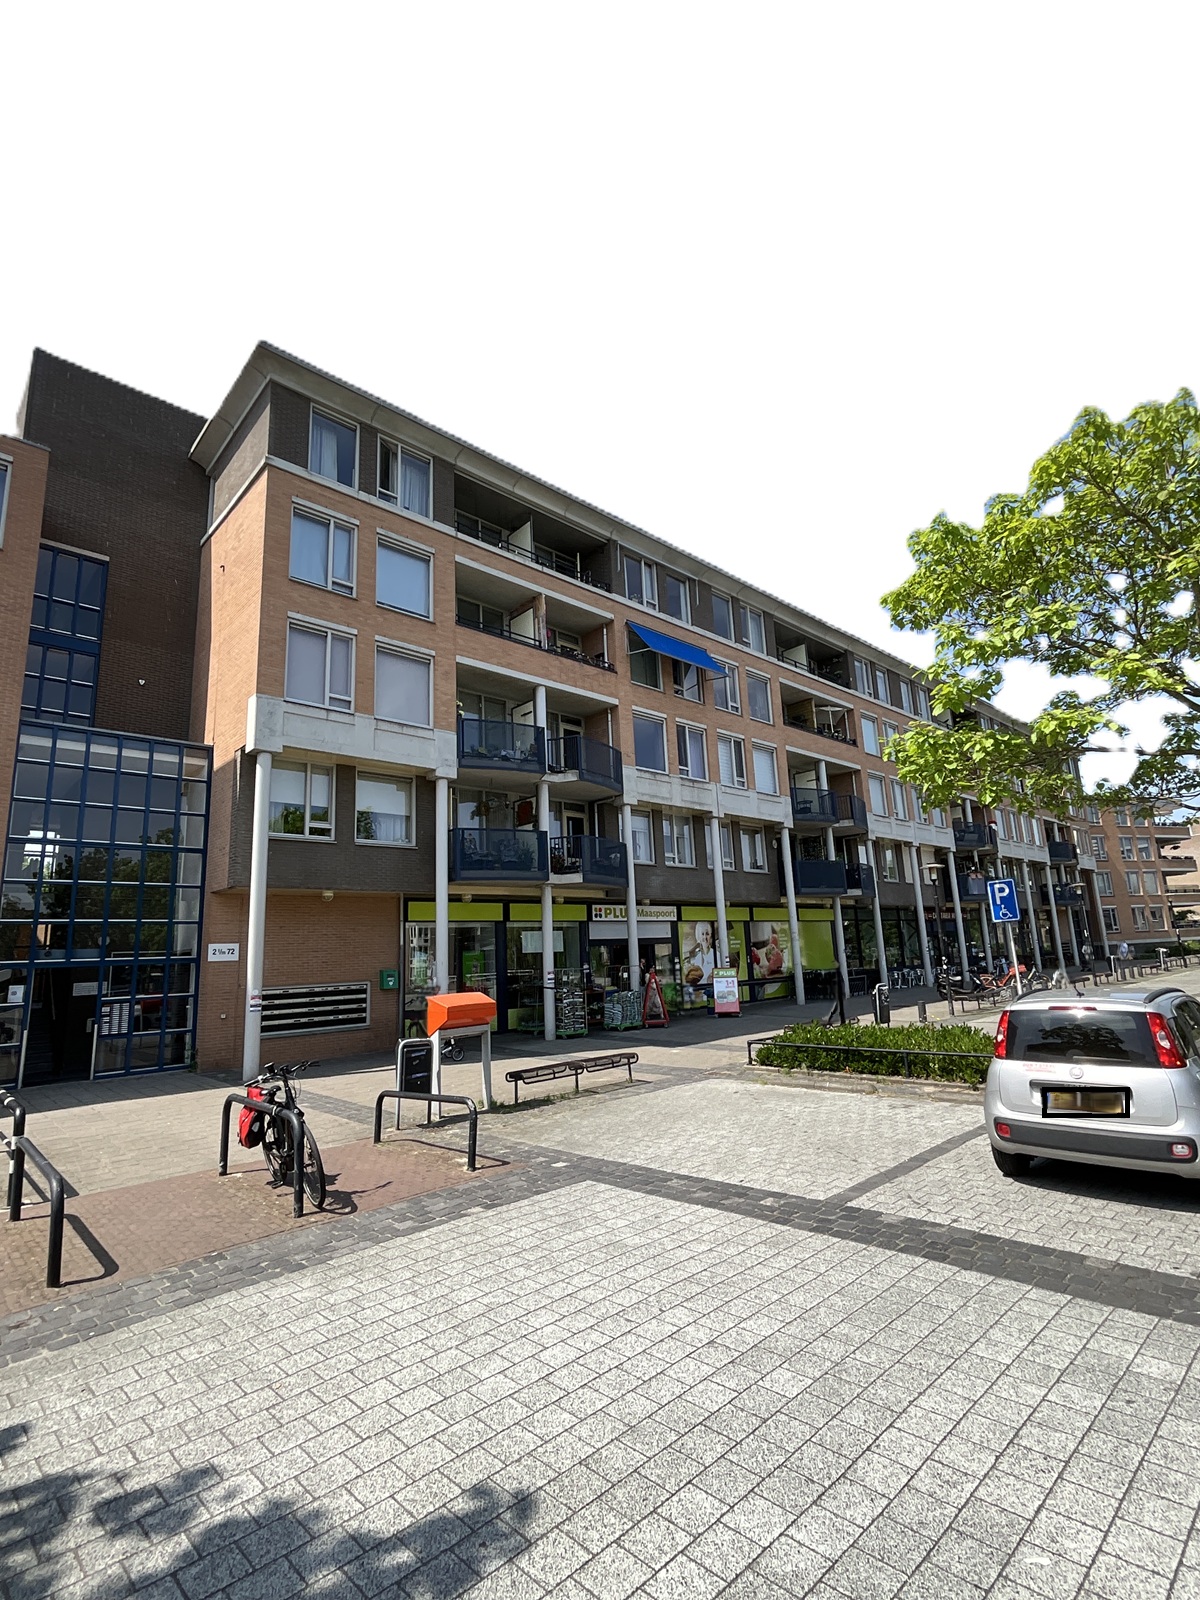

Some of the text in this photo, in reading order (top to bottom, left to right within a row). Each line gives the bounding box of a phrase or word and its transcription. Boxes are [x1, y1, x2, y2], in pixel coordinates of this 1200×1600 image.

[993, 883, 1010, 905] P
[604, 907, 676, 919] PLU Maaspoort
